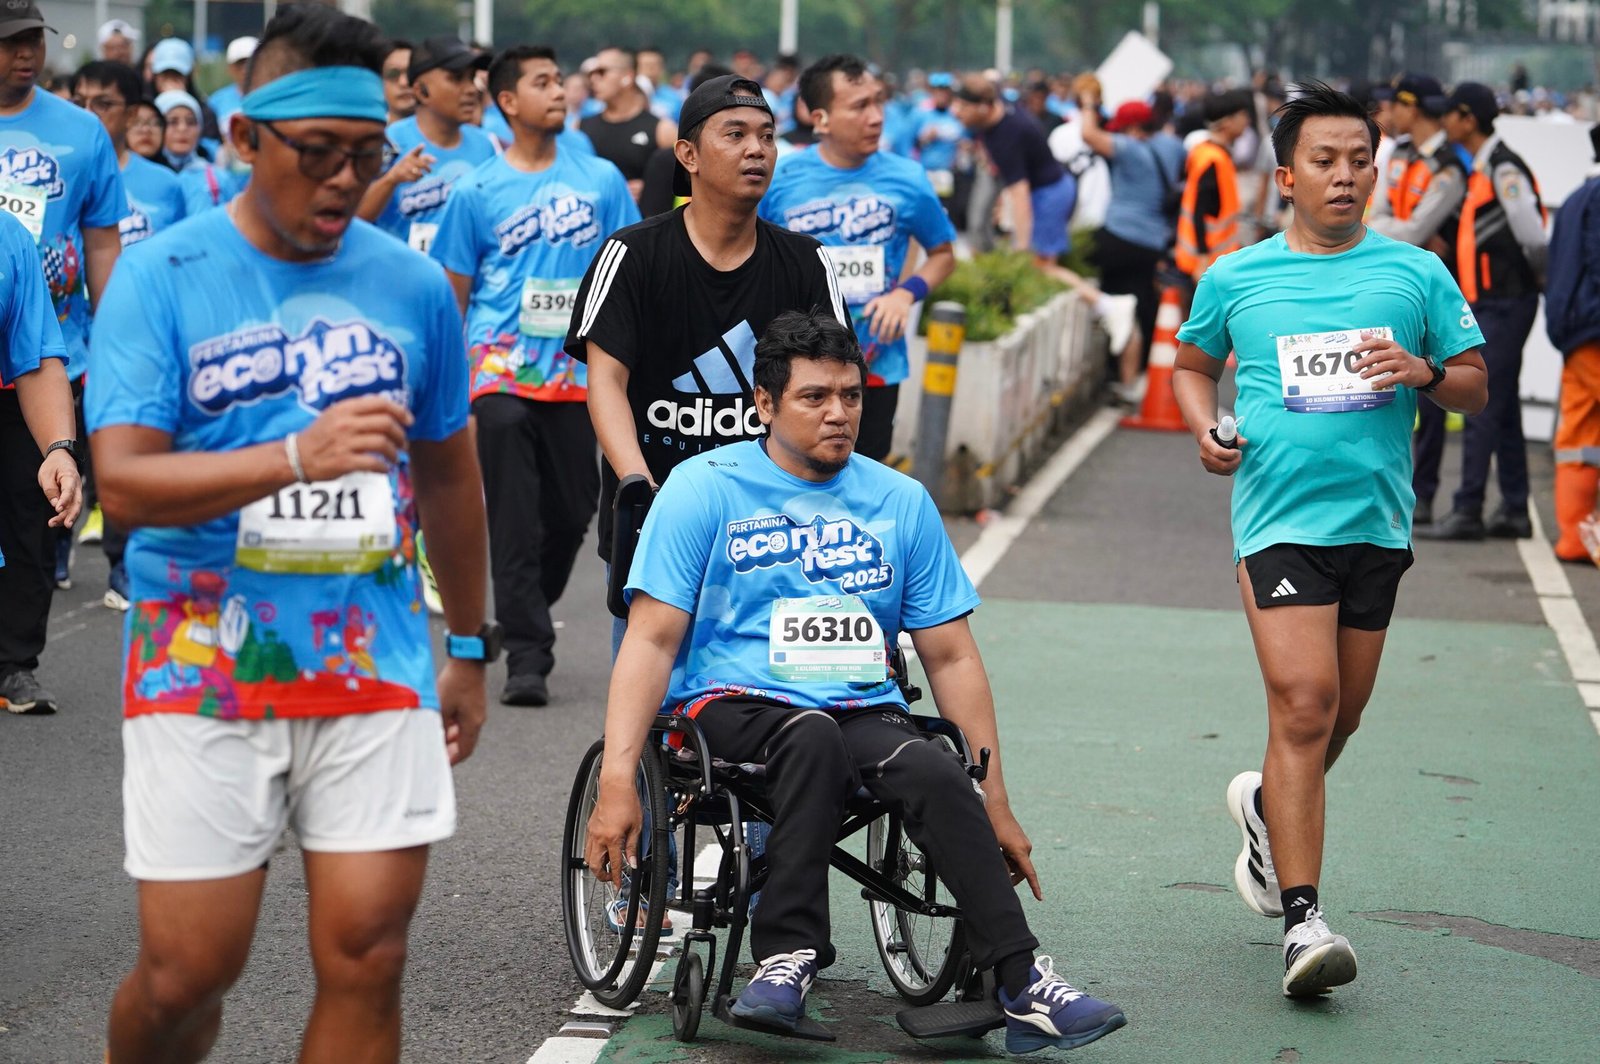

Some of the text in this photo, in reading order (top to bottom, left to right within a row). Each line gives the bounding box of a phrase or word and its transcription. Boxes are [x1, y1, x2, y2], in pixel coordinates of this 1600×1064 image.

[192, 347, 284, 401] eco
[1292, 350, 1375, 377] 1670
[268, 489, 365, 520] 11211
[729, 516, 788, 535] PERTAMINA
[730, 531, 788, 561] eco
[801, 536, 872, 572] fest
[842, 566, 889, 589] 2025
[782, 616, 873, 643] 56310
